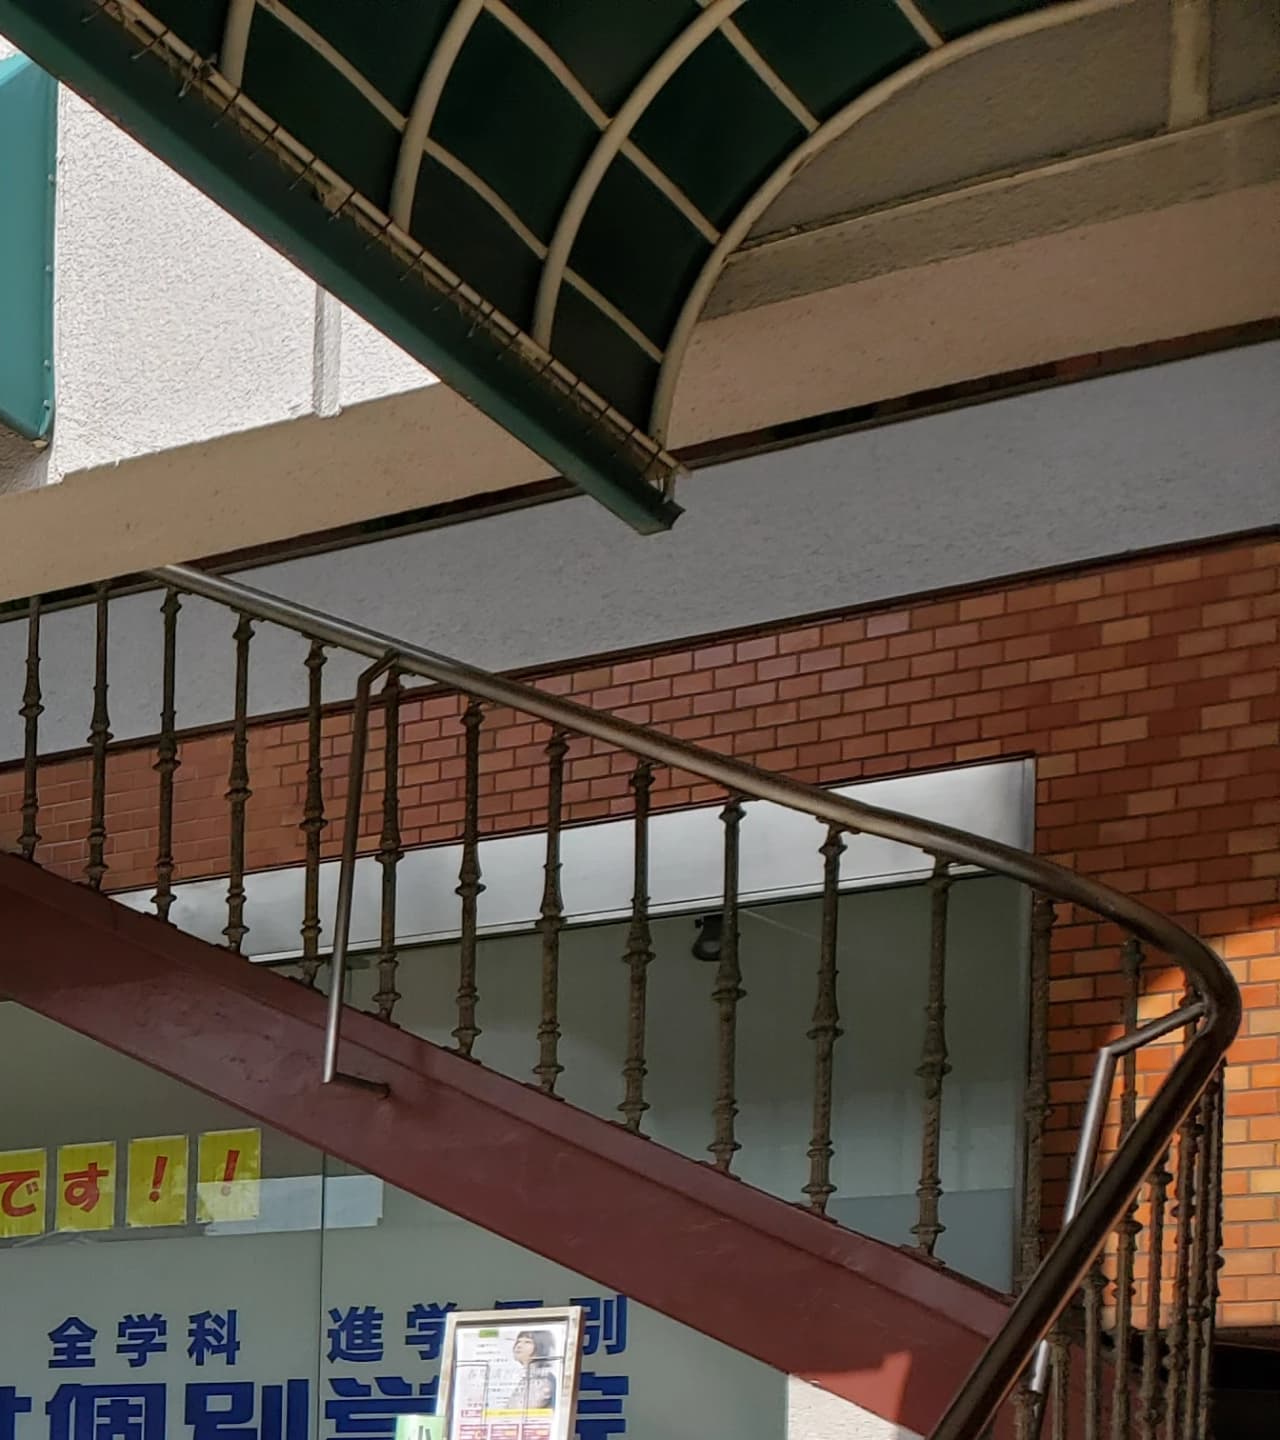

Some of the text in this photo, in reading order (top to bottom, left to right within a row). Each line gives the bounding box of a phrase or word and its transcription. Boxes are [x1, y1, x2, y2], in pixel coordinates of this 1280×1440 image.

[48, 1309, 241, 1369] 全学科
[327, 1294, 628, 1363] 進学別
